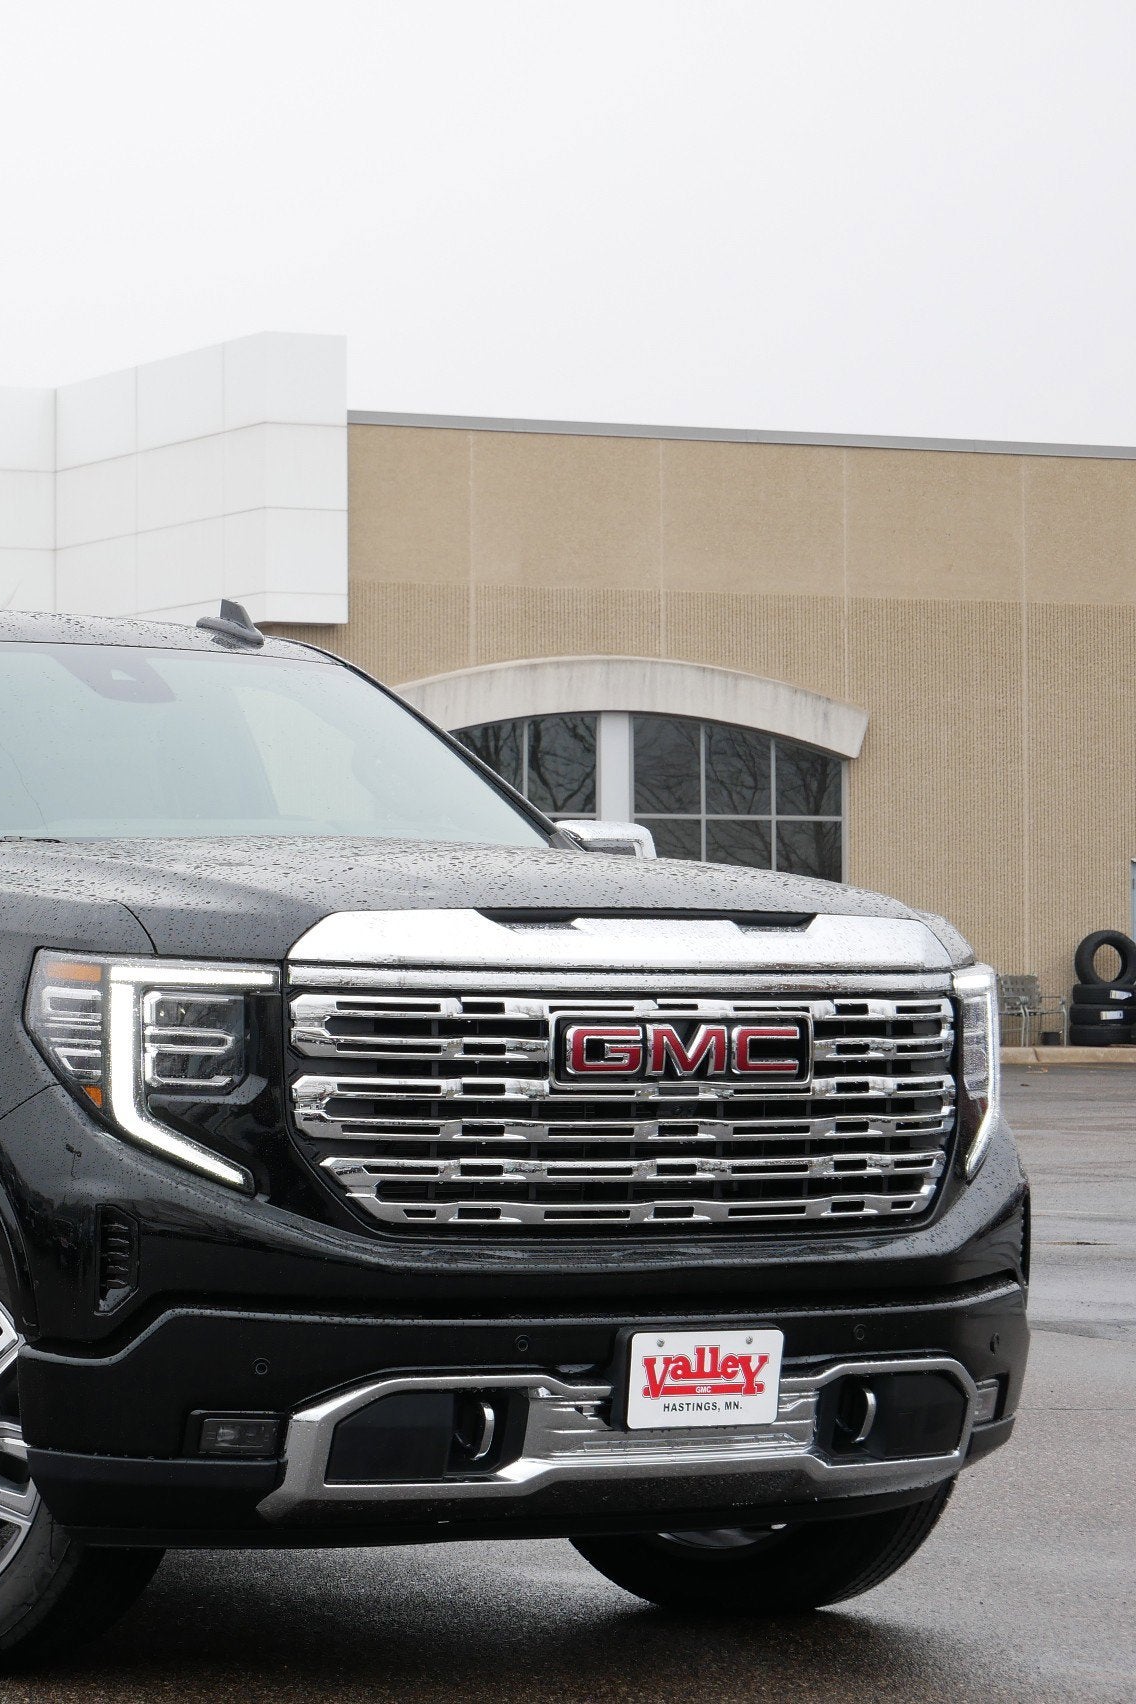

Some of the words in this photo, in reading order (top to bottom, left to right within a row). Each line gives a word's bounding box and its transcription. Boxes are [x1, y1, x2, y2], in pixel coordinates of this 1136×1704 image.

[566, 1023, 800, 1077] GMC
[642, 1345, 770, 1400] Valley
[695, 1385, 712, 1394] GMC
[663, 1401, 721, 1413] HASTINGS,
[724, 1400, 743, 1411] MN.
